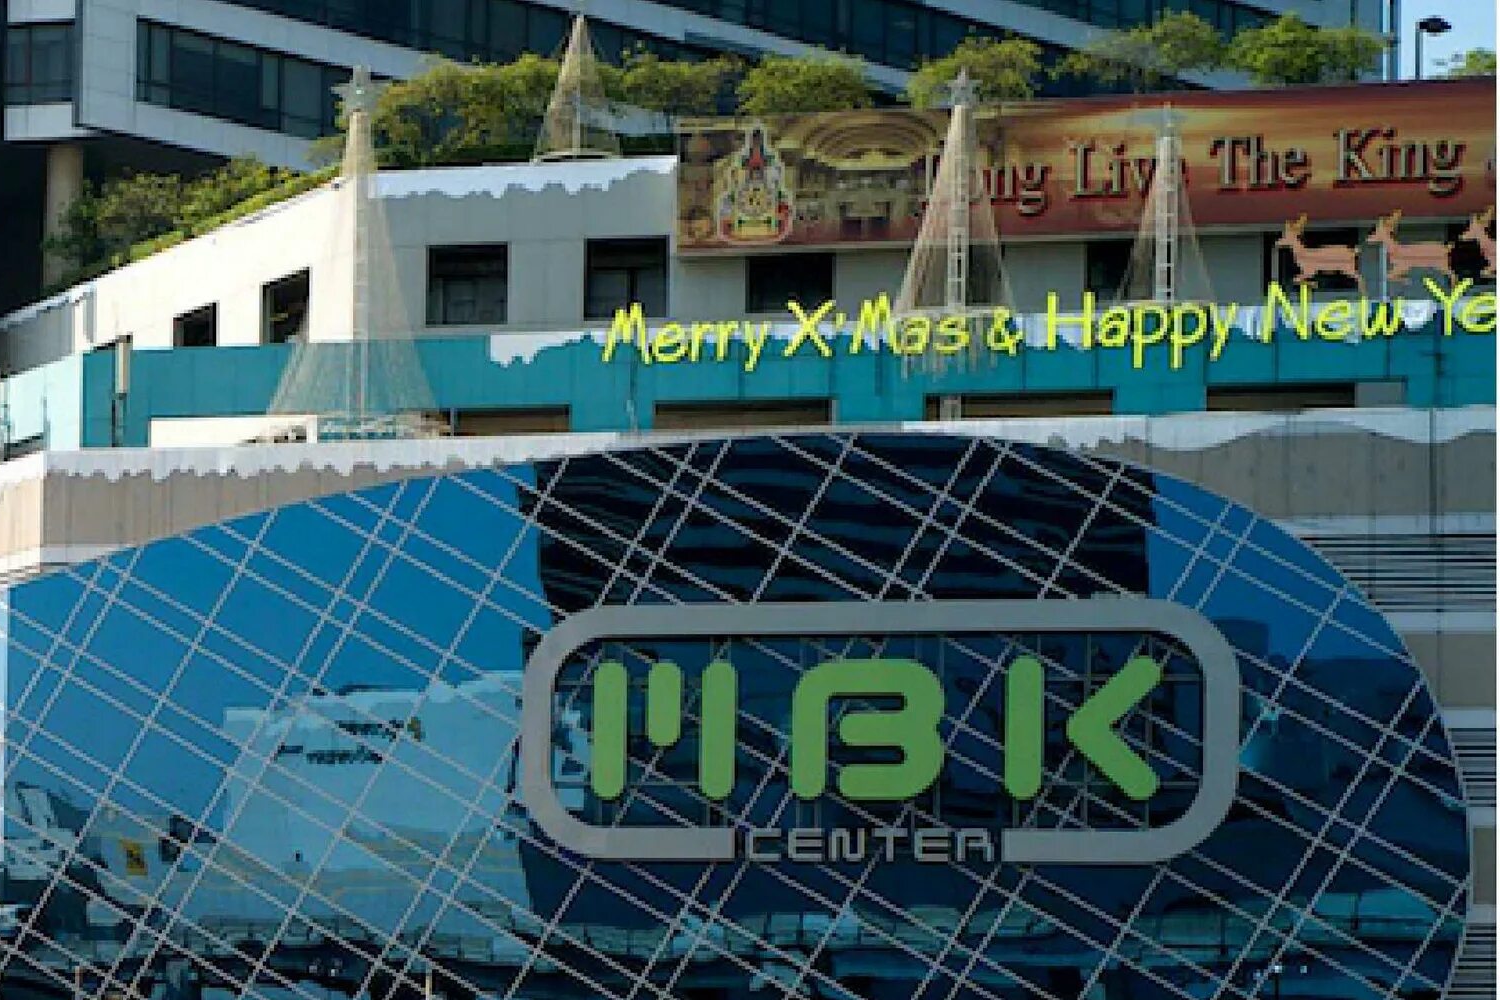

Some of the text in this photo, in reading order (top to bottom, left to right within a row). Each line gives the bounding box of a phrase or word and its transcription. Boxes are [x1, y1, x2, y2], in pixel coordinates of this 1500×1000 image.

[1068, 136, 1187, 200] Liv
[1210, 133, 1311, 192] The
[1332, 125, 1467, 197] King
[602, 277, 1496, 372] Merry X'Mas & Happy New Ye
[589, 656, 1163, 800] MBK
[747, 826, 998, 863] CENTER
